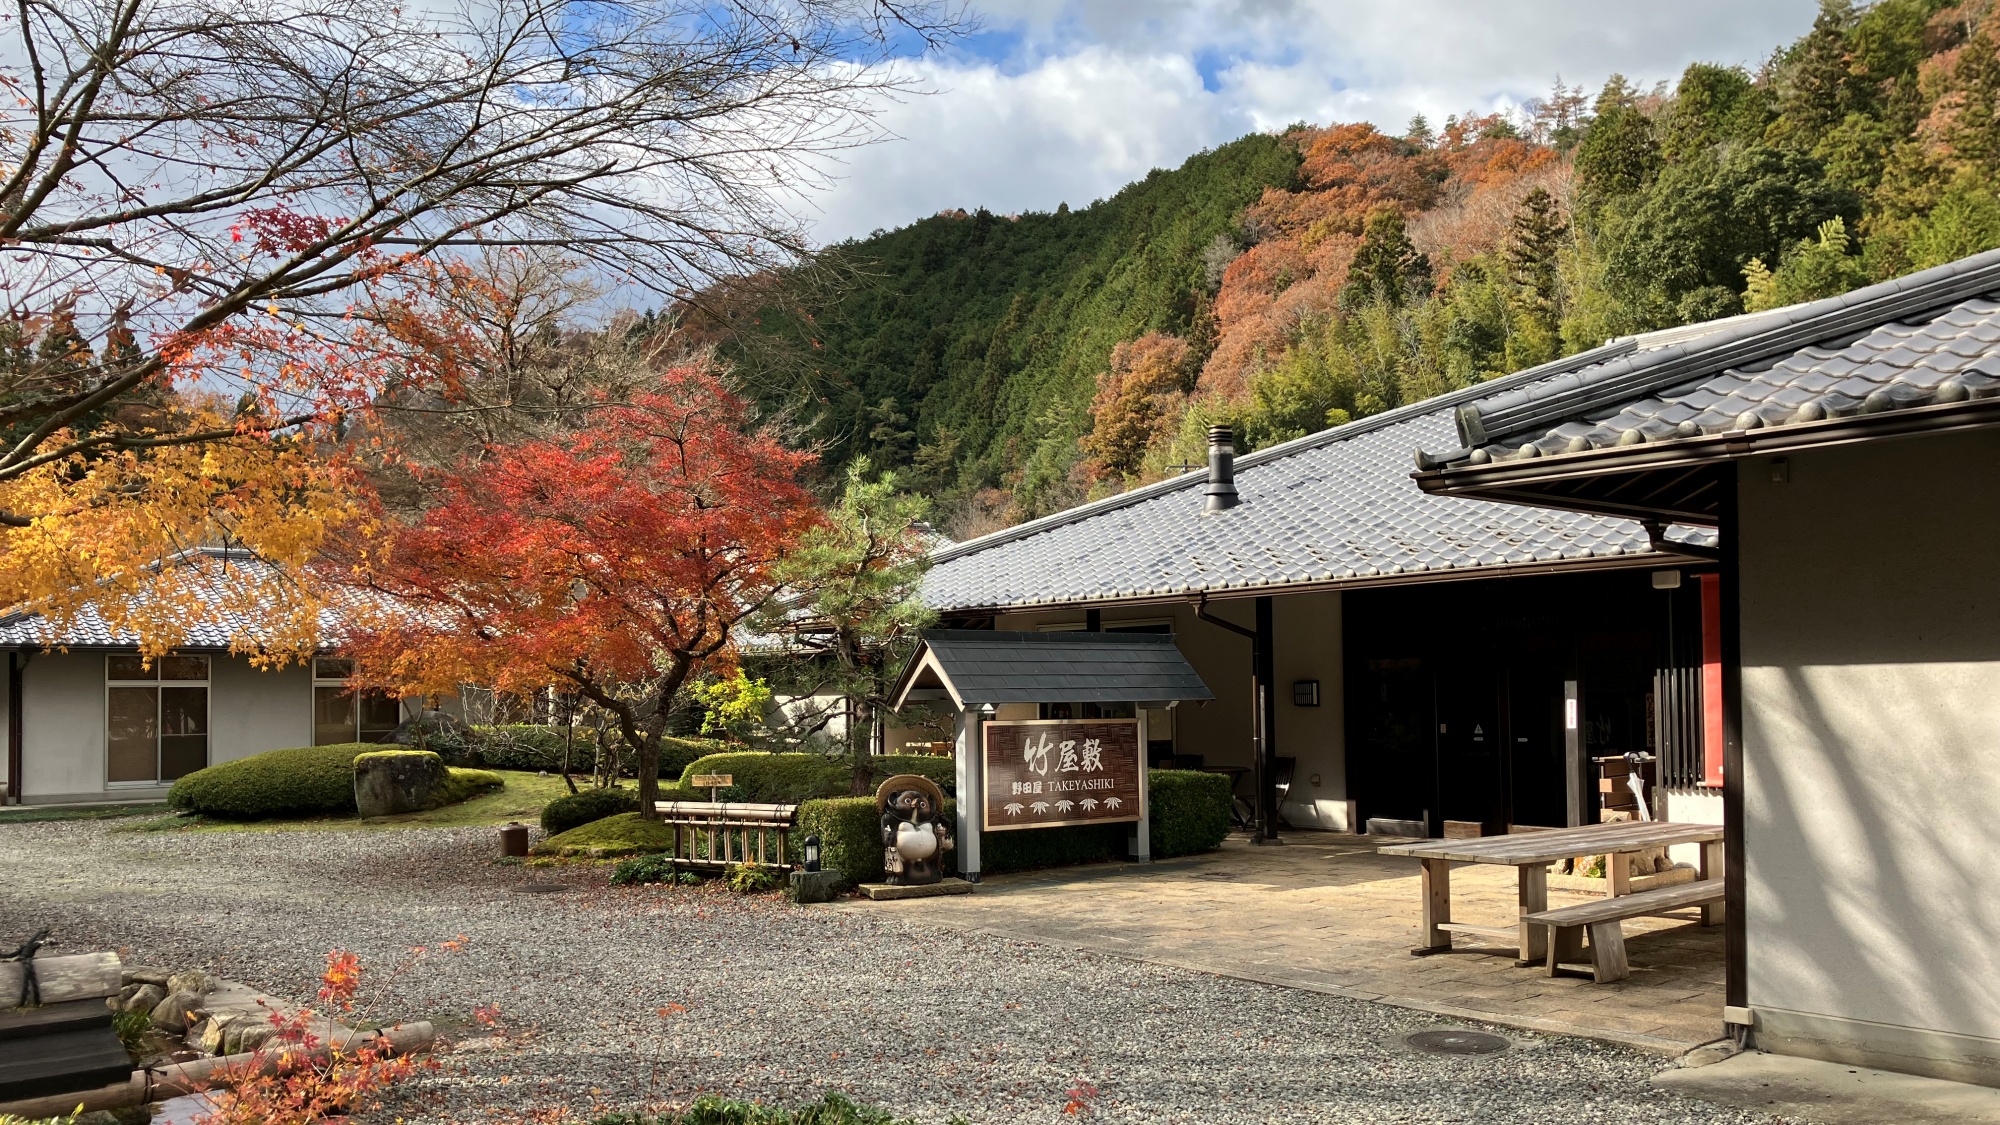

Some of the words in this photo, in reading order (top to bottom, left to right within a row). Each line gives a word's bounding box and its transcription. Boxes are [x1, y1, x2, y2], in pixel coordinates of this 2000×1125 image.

[1024, 731, 1103, 776] 竹屋敷
[1012, 781, 1043, 795] 野田屋
[1048, 778, 1114, 792] TAKEYASHIKI
